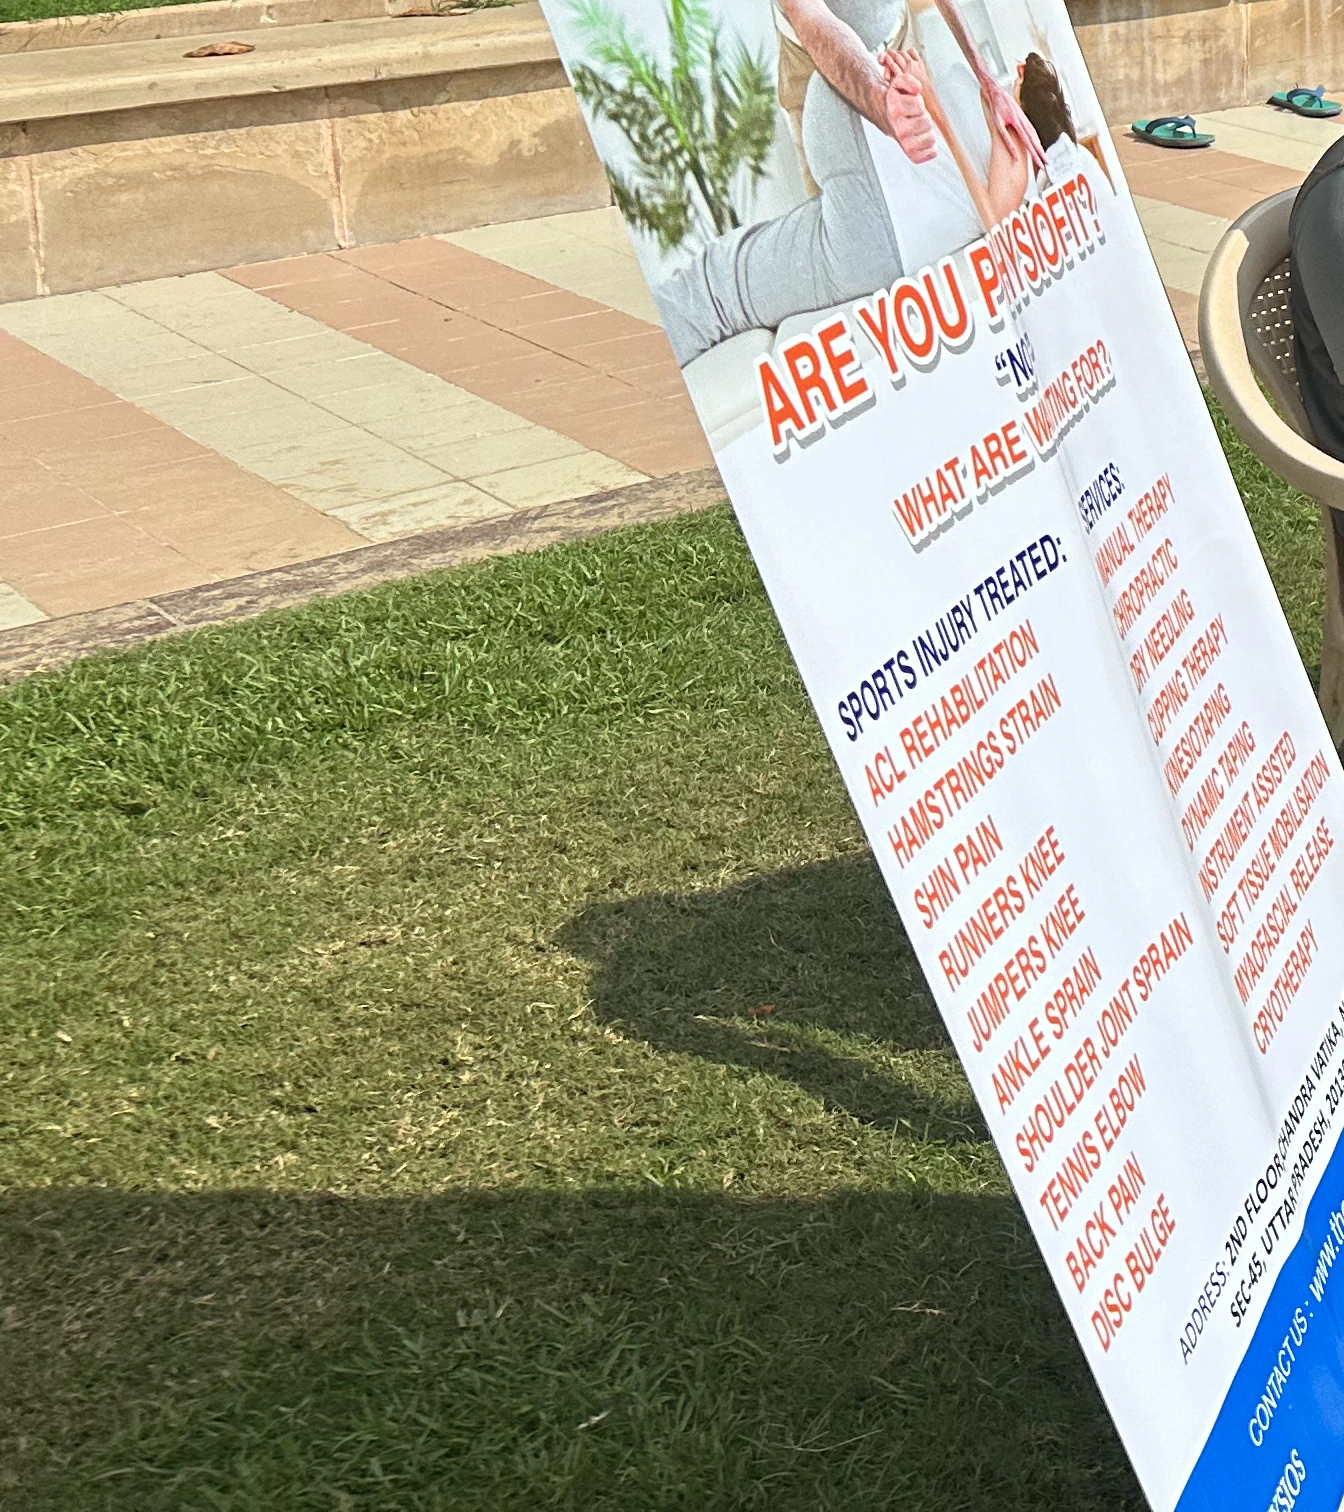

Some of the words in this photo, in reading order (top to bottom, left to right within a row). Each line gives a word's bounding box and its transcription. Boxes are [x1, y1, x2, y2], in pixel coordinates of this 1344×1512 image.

[757, 319, 869, 447] ARE
[858, 272, 969, 376] YOU
[969, 172, 1103, 318] PHYSIOFIT?
[894, 456, 967, 538] WHAT
[970, 420, 1028, 488] ARE
[1071, 339, 1112, 399] FOR?
[1095, 522, 1135, 589] MANUAL
[1127, 472, 1176, 540] THERAPY
[1113, 538, 1178, 641] CHIROPRACTIC
[838, 649, 918, 742] SPORTS
[912, 594, 980, 677] INJURY
[973, 534, 1068, 622] TREATED:
[865, 746, 907, 807] ACL
[899, 619, 1040, 769] REHABILITATION
[1129, 638, 1149, 696] DRY
[1144, 589, 1195, 666] NEEDLING
[1147, 669, 1190, 747] CUPPING
[1181, 613, 1229, 689] THERAPY
[887, 731, 1004, 869] HAMSTRINGS
[1000, 673, 1062, 755] STRAIN
[1164, 683, 1233, 800] KINESIOTAPING
[1181, 767, 1225, 854] DYNAMIC
[1218, 720, 1257, 790] TAPING
[1198, 789, 1262, 904] INSTRUMENT
[1253, 731, 1297, 816] ASSISTED
[913, 857, 962, 930] SHIN
[953, 814, 1003, 885] PAIN
[937, 874, 1025, 993] RUNNERS
[1018, 825, 1065, 899] KNEE
[1216, 889, 1245, 955] SOFT
[1238, 843, 1276, 916] TISSUE
[1272, 750, 1331, 862] MOBILISATION
[1234, 885, 1298, 1007] MYAOFASCIAL
[1290, 817, 1335, 901] RELEASE
[966, 935, 1047, 1053] JUMPERS
[1039, 884, 1086, 959] KNEE
[990, 1017, 1052, 1116] ANKLE
[1044, 945, 1102, 1041] SPRAIN
[1015, 1037, 1103, 1173] SHOULDER
[1096, 978, 1139, 1059] JOINT
[1132, 912, 1194, 1002] SPRAIN
[1252, 919, 1319, 1055] CRYOTHERAPY
[1040, 1131, 1101, 1231] TENNIS
[1094, 1053, 1146, 1152] ELBOW
[1065, 1201, 1117, 1294] BACK
[1107, 1151, 1146, 1226] PAIN
[1179, 1260, 1230, 1365] ADDRESS:
[1225, 1215, 1249, 1267] 2ND
[1310, 1021, 1344, 1081] VATIKA,
[1091, 1272, 1132, 1353] DISC
[1125, 1193, 1176, 1293] BULGE
[1230, 1252, 1267, 1328] SEC-45,
[1249, 1335, 1297, 1447] CONTACT
